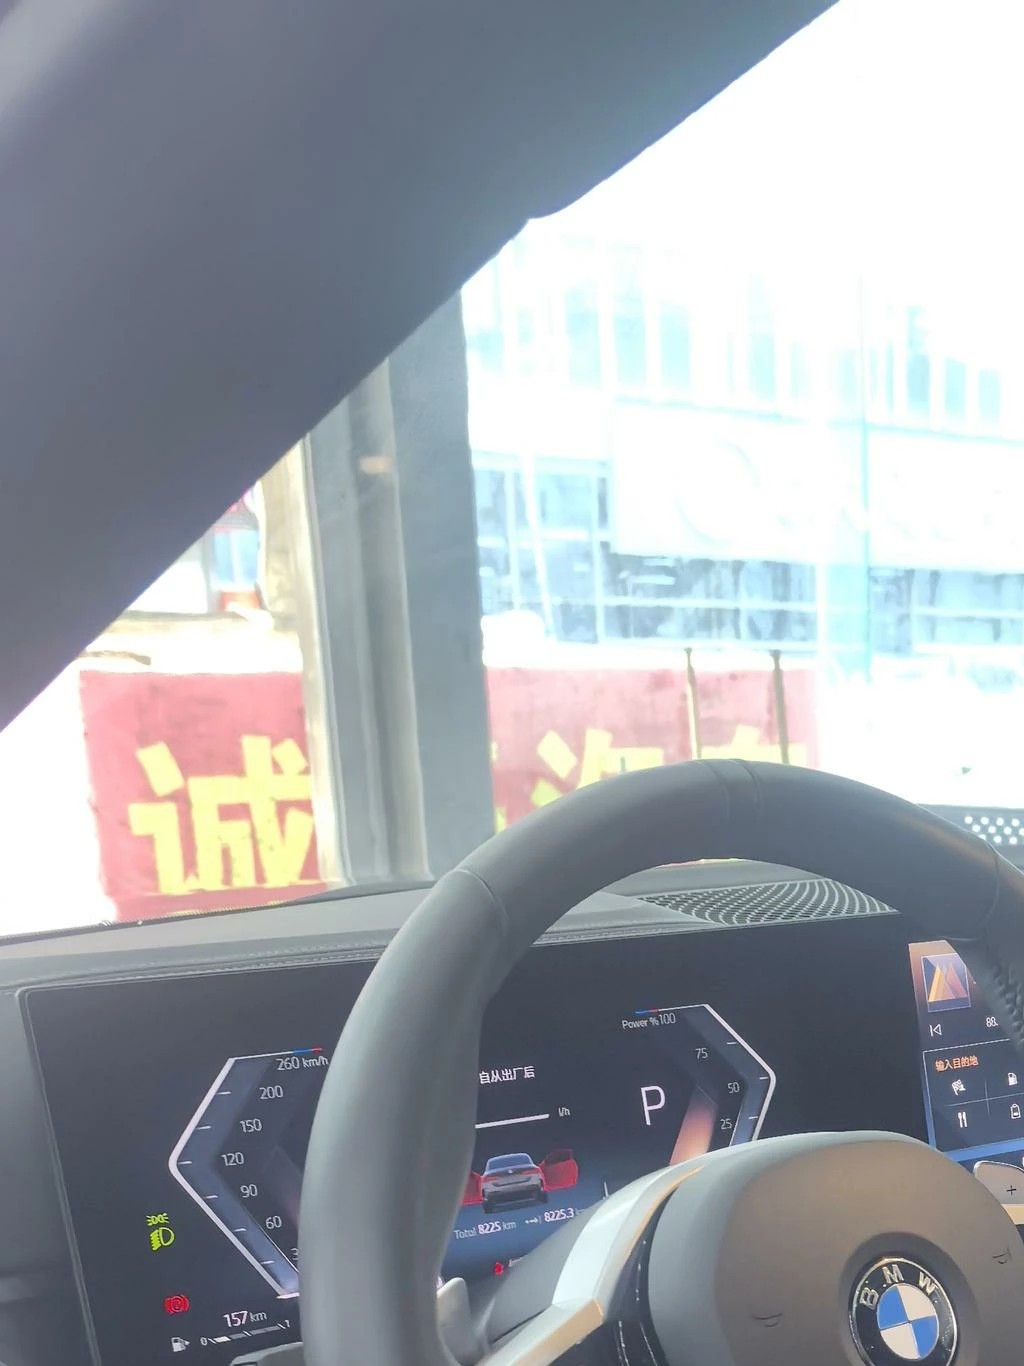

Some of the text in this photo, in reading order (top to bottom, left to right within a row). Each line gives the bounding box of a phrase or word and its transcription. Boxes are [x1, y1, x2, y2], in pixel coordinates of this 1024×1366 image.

[621, 1018, 648, 1030] Power
[659, 1012, 676, 1026] 100
[985, 1016, 999, 1028] 88.
[695, 1047, 709, 1060] 75
[275, 1055, 329, 1071] 260 km/h
[935, 1055, 980, 1072] 输入目的地
[478, 1065, 536, 1085] 自从出厂后
[259, 1085, 284, 1100] 200
[727, 1081, 741, 1094] 50
[640, 1085, 666, 1126] P
[239, 1118, 263, 1133] 150
[720, 1118, 733, 1130] 25
[221, 1151, 245, 1167] 120
[240, 1183, 258, 1198] 90
[265, 1215, 282, 1230] 60
[543, 1207, 575, 1223] 8225.3
[453, 1220, 517, 1240] Total 8225 km
[290, 1248, 299, 1261] 3
[859, 1263, 939, 1311] BMW
[223, 1310, 268, 1328] 157 km
